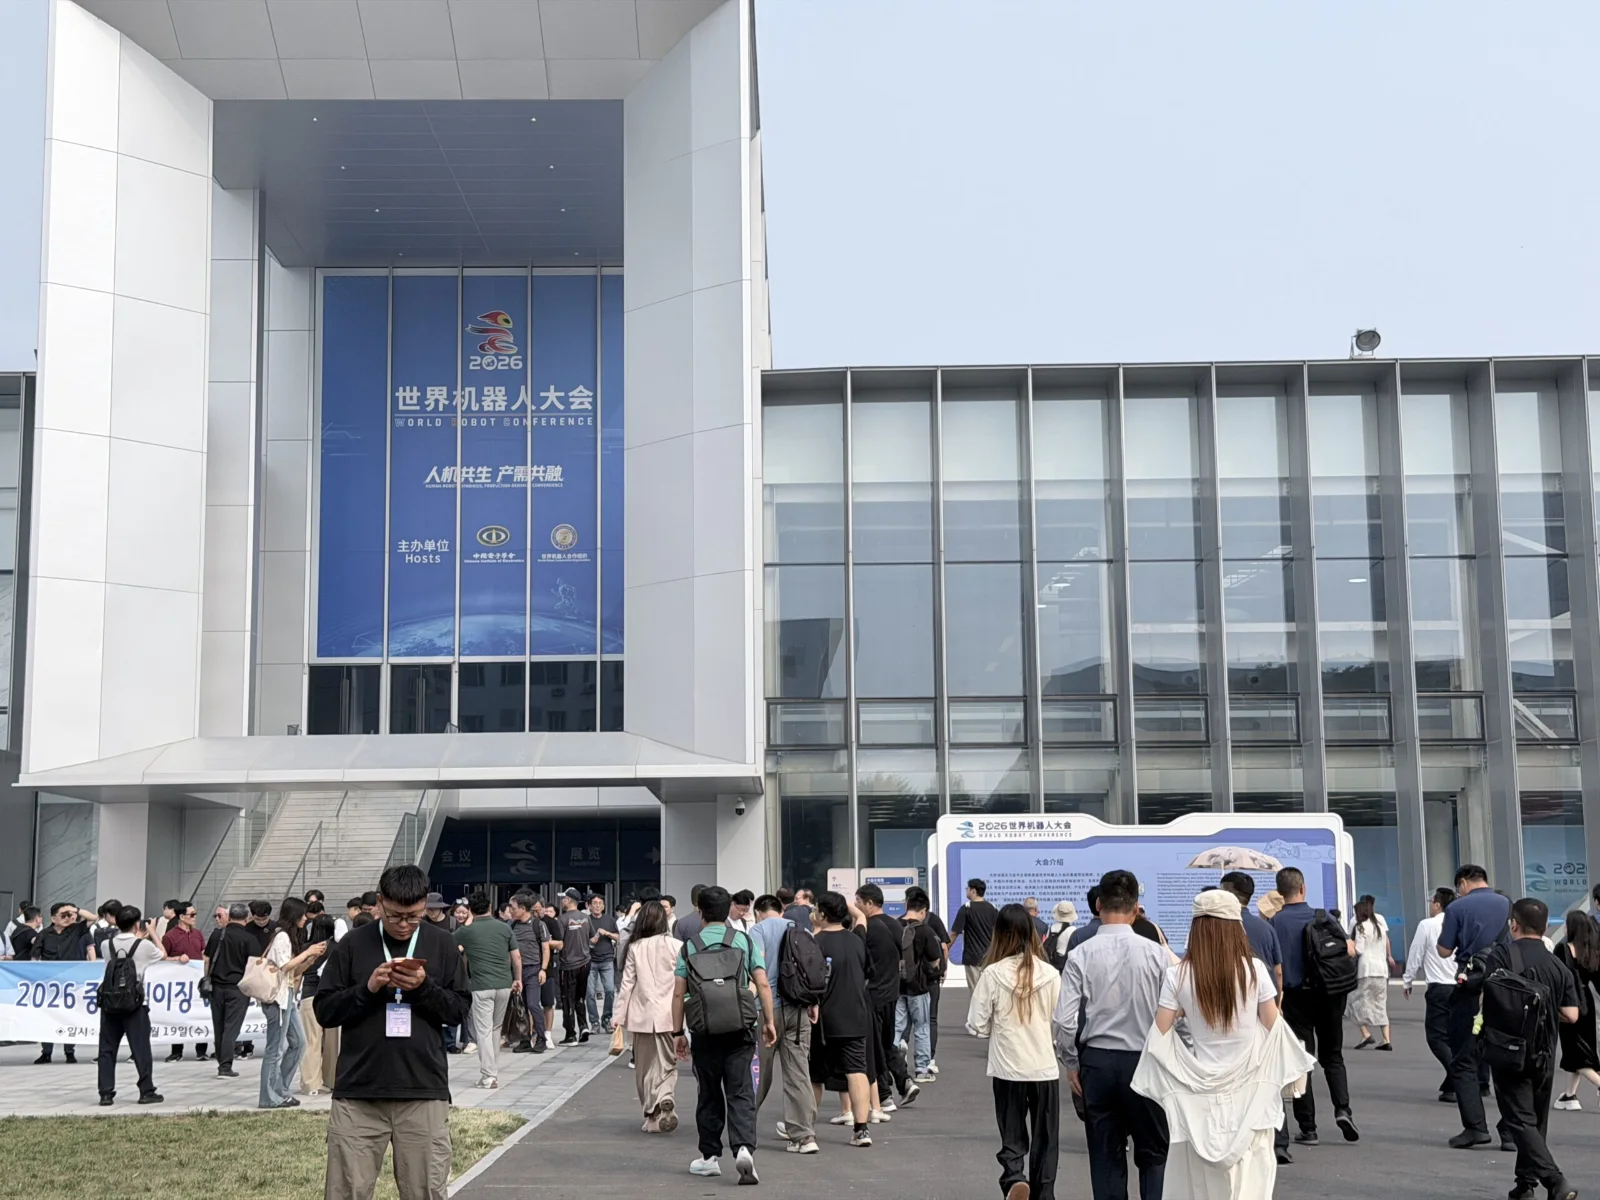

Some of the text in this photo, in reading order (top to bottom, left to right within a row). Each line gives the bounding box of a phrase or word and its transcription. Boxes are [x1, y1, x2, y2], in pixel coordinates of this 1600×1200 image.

[469, 355, 523, 371] 2026
[395, 384, 594, 412] 世界机器人大会
[395, 416, 594, 427] WORLD ROBOT CONFERENCE
[424, 465, 564, 483] 人机共生 产需共融
[397, 539, 450, 553] 主办单位
[405, 553, 441, 564] Hosts
[1035, 858, 1064, 867] 大会介绍
[1553, 862, 1587, 875] 202
[1554, 878, 1587, 886] WORLD
[15, 982, 76, 1010] 2026
[147, 980, 193, 1014] 이징
[163, 1025, 209, 1038] 19일(수)
